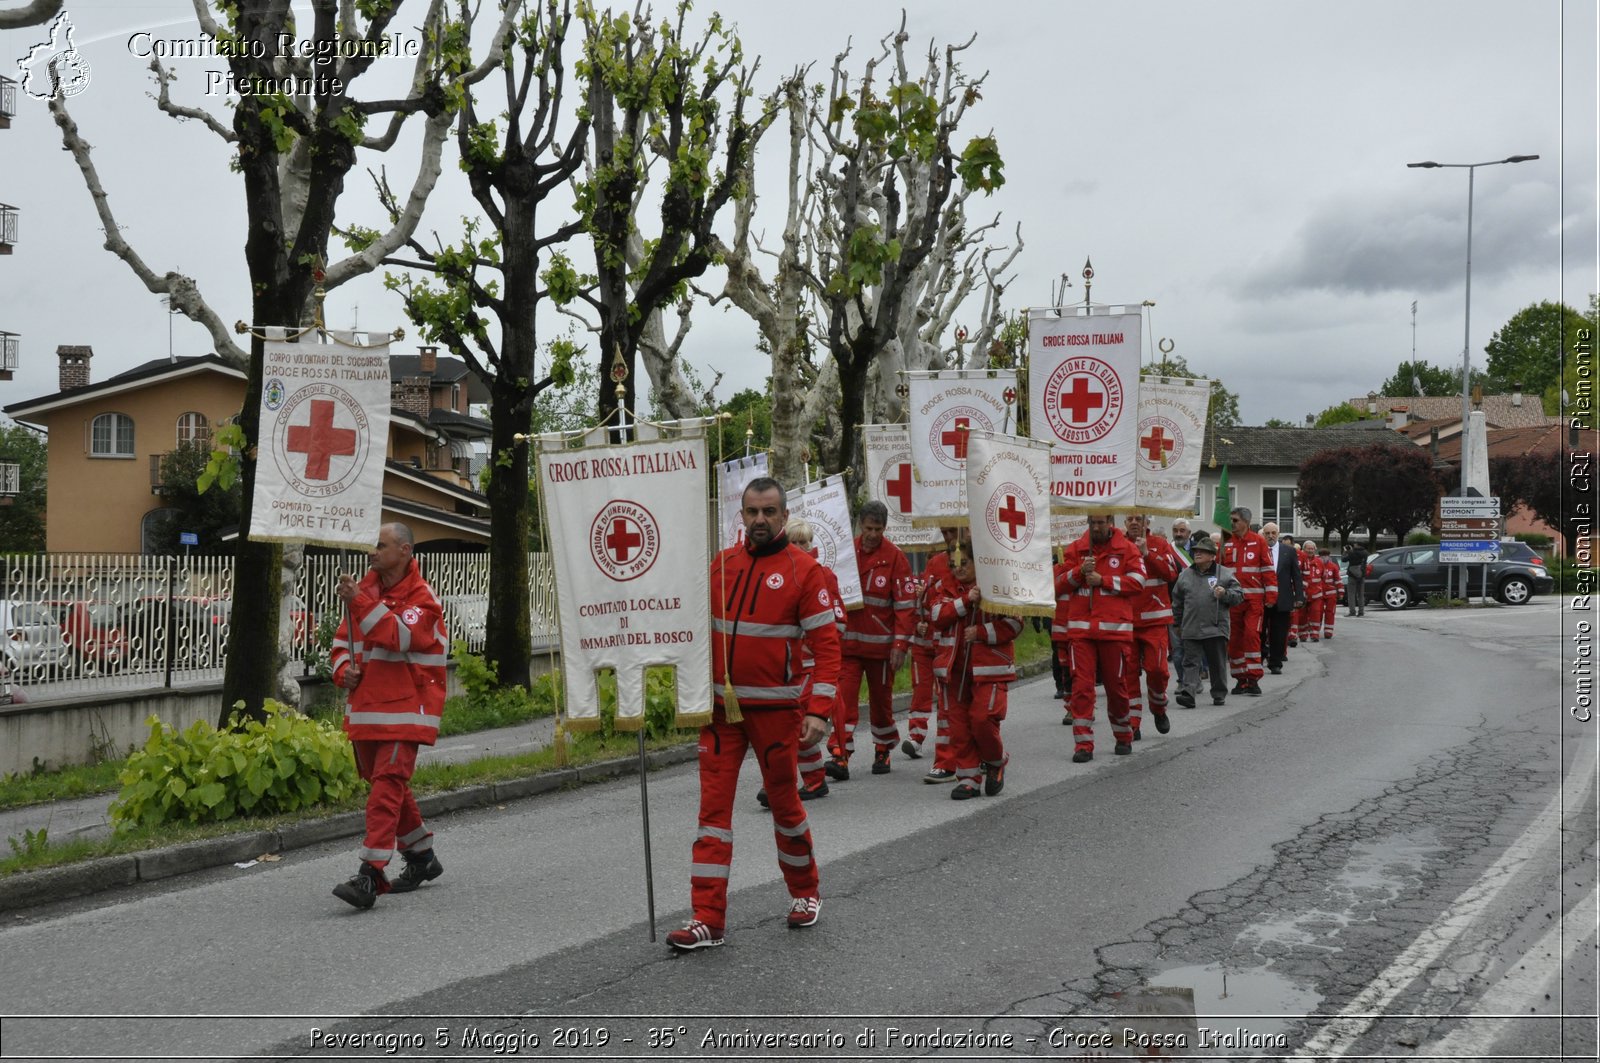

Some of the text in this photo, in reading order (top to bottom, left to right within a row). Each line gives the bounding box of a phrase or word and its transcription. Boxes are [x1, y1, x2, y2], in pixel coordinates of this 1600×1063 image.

[1043, 333, 1124, 347] CROCE ROSSA ITALIANA
[269, 352, 383, 367] CORPO VOLONTARI DEL SOCCORSO
[265, 365, 389, 380] CROCE ROSSA ITALIANA
[1047, 360, 1119, 410] CONVENZIONE DI GINEVRA
[278, 384, 326, 426] CONVENZIONE
[330, 386, 340, 396] DI
[340, 393, 368, 430] GINEVRA
[920, 387, 1004, 415] CROCE ROSSA ITALIANA
[1054, 420, 1110, 441] 22 AGOSTO 1864
[930, 420, 947, 462] CONVENZIONE
[549, 449, 697, 483] CROCE ROSSA ITALIANA
[1050, 454, 1118, 464] OMITATO LOCALE
[977, 451, 1044, 496] CROCE ROSSA ITALIANA
[1073, 467, 1083, 476] di
[923, 479, 966, 488] COMITATO
[271, 500, 312, 512] COMITATO
[323, 505, 365, 518] LOCALE
[940, 501, 969, 510] DRON
[279, 513, 352, 532] MORETTA
[637, 513, 647, 524] 22
[814, 509, 847, 541] ITALIANA
[644, 524, 655, 557] AGOSTO
[630, 557, 648, 573] 1864
[978, 557, 1044, 572] COMITATO LOCALE
[1012, 572, 1020, 581] DI
[579, 597, 682, 617] COMITATO LOCALE
[620, 616, 629, 629] DI
[627, 632, 651, 645] DEL
[653, 630, 693, 645] BOSCO
